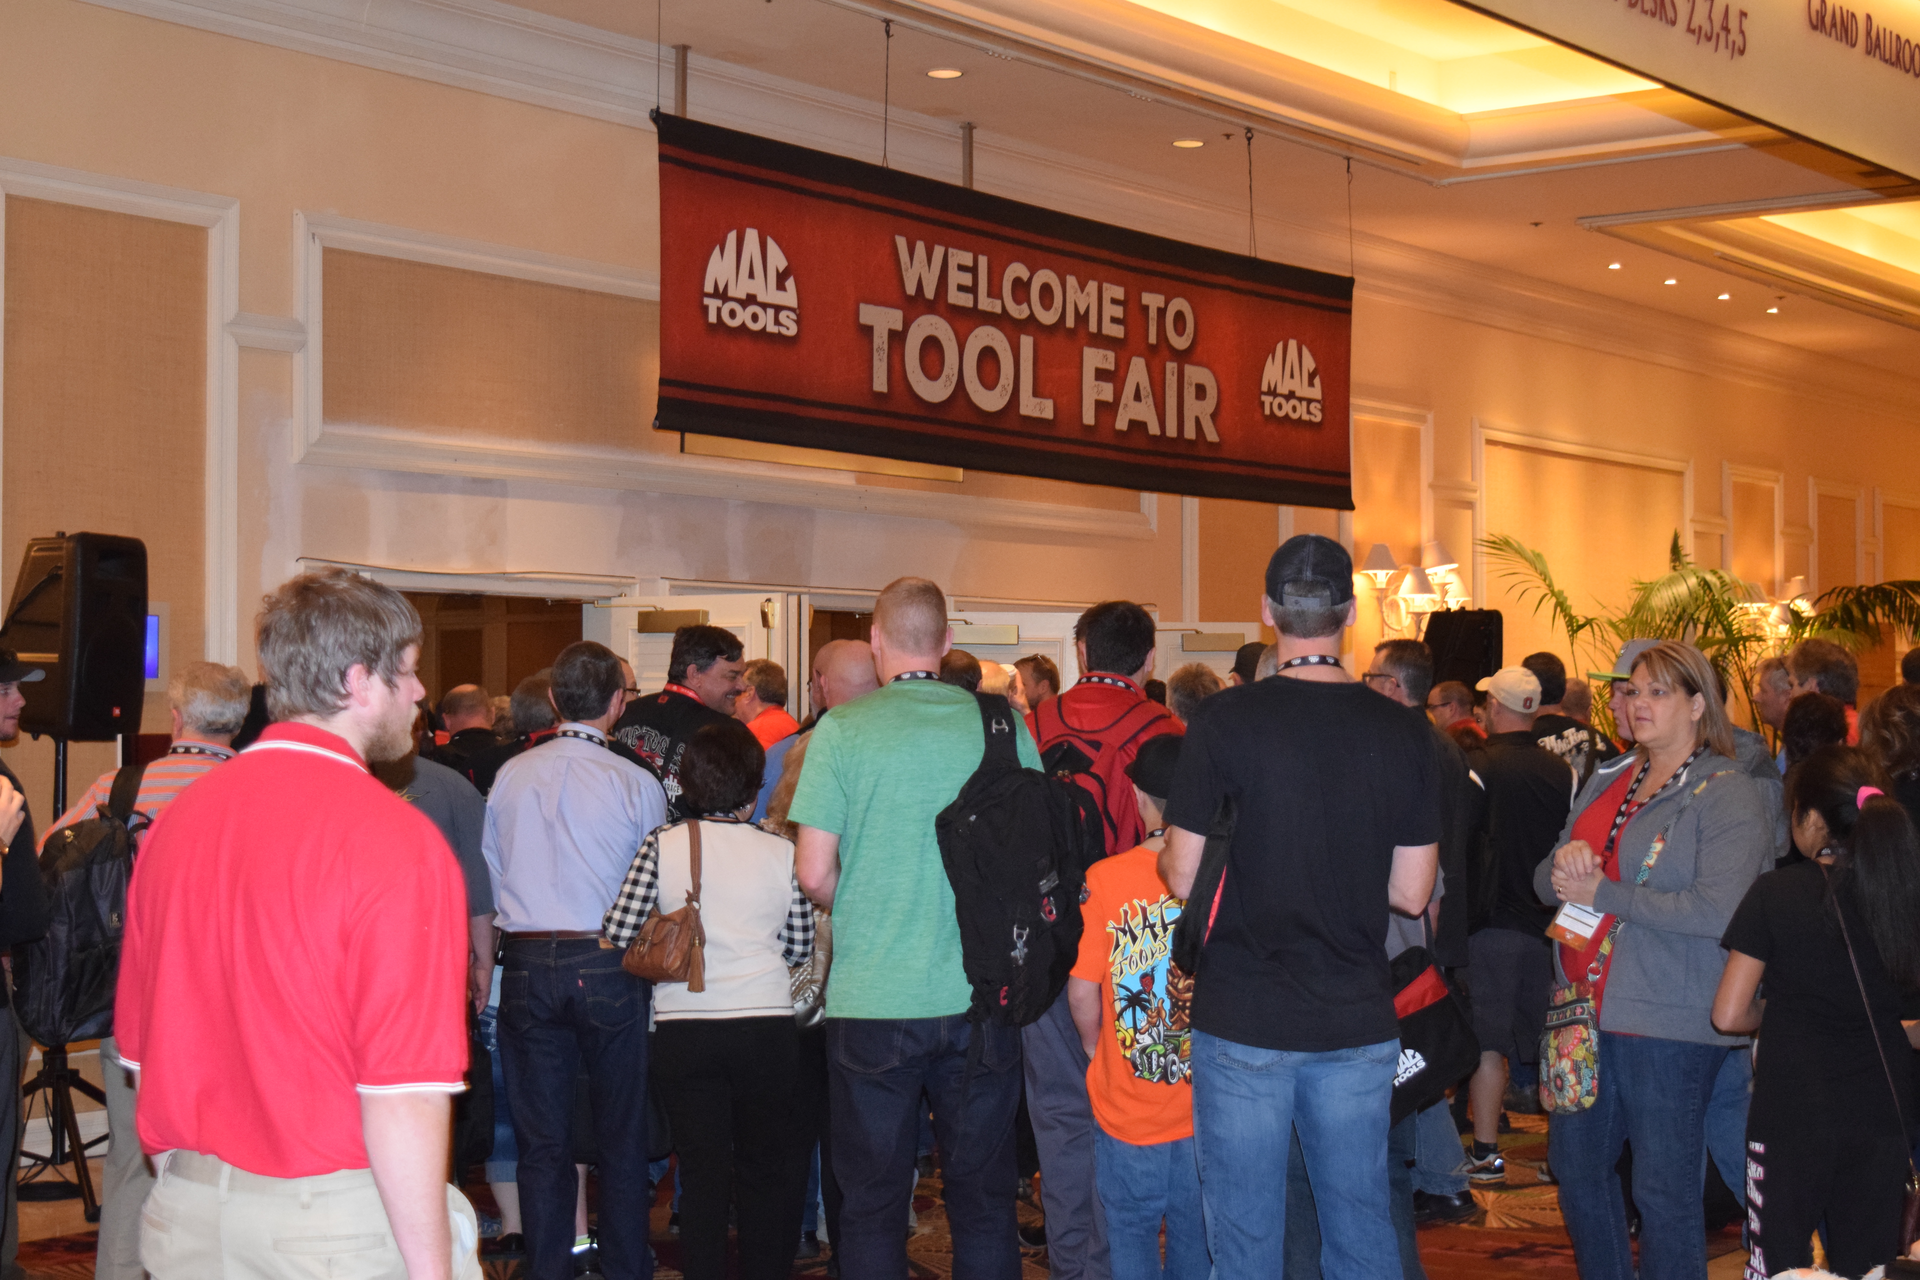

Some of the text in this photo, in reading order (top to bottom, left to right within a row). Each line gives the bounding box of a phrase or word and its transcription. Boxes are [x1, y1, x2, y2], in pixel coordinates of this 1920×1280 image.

[1685, 0, 1748, 60] 2,3,4,5
[1807, 0, 1858, 49] GRAND
[704, 227, 798, 309] MAC
[895, 234, 1195, 350] WELCOME TO
[703, 297, 798, 337] TOOLS
[859, 302, 1220, 443] TOOL FAIR
[1261, 338, 1322, 401] MAC
[1261, 395, 1322, 423] TOOLS
[1111, 934, 1170, 983] TOOLS
[1393, 1059, 1426, 1087] TOOLS
[1397, 1048, 1423, 1075] AC
